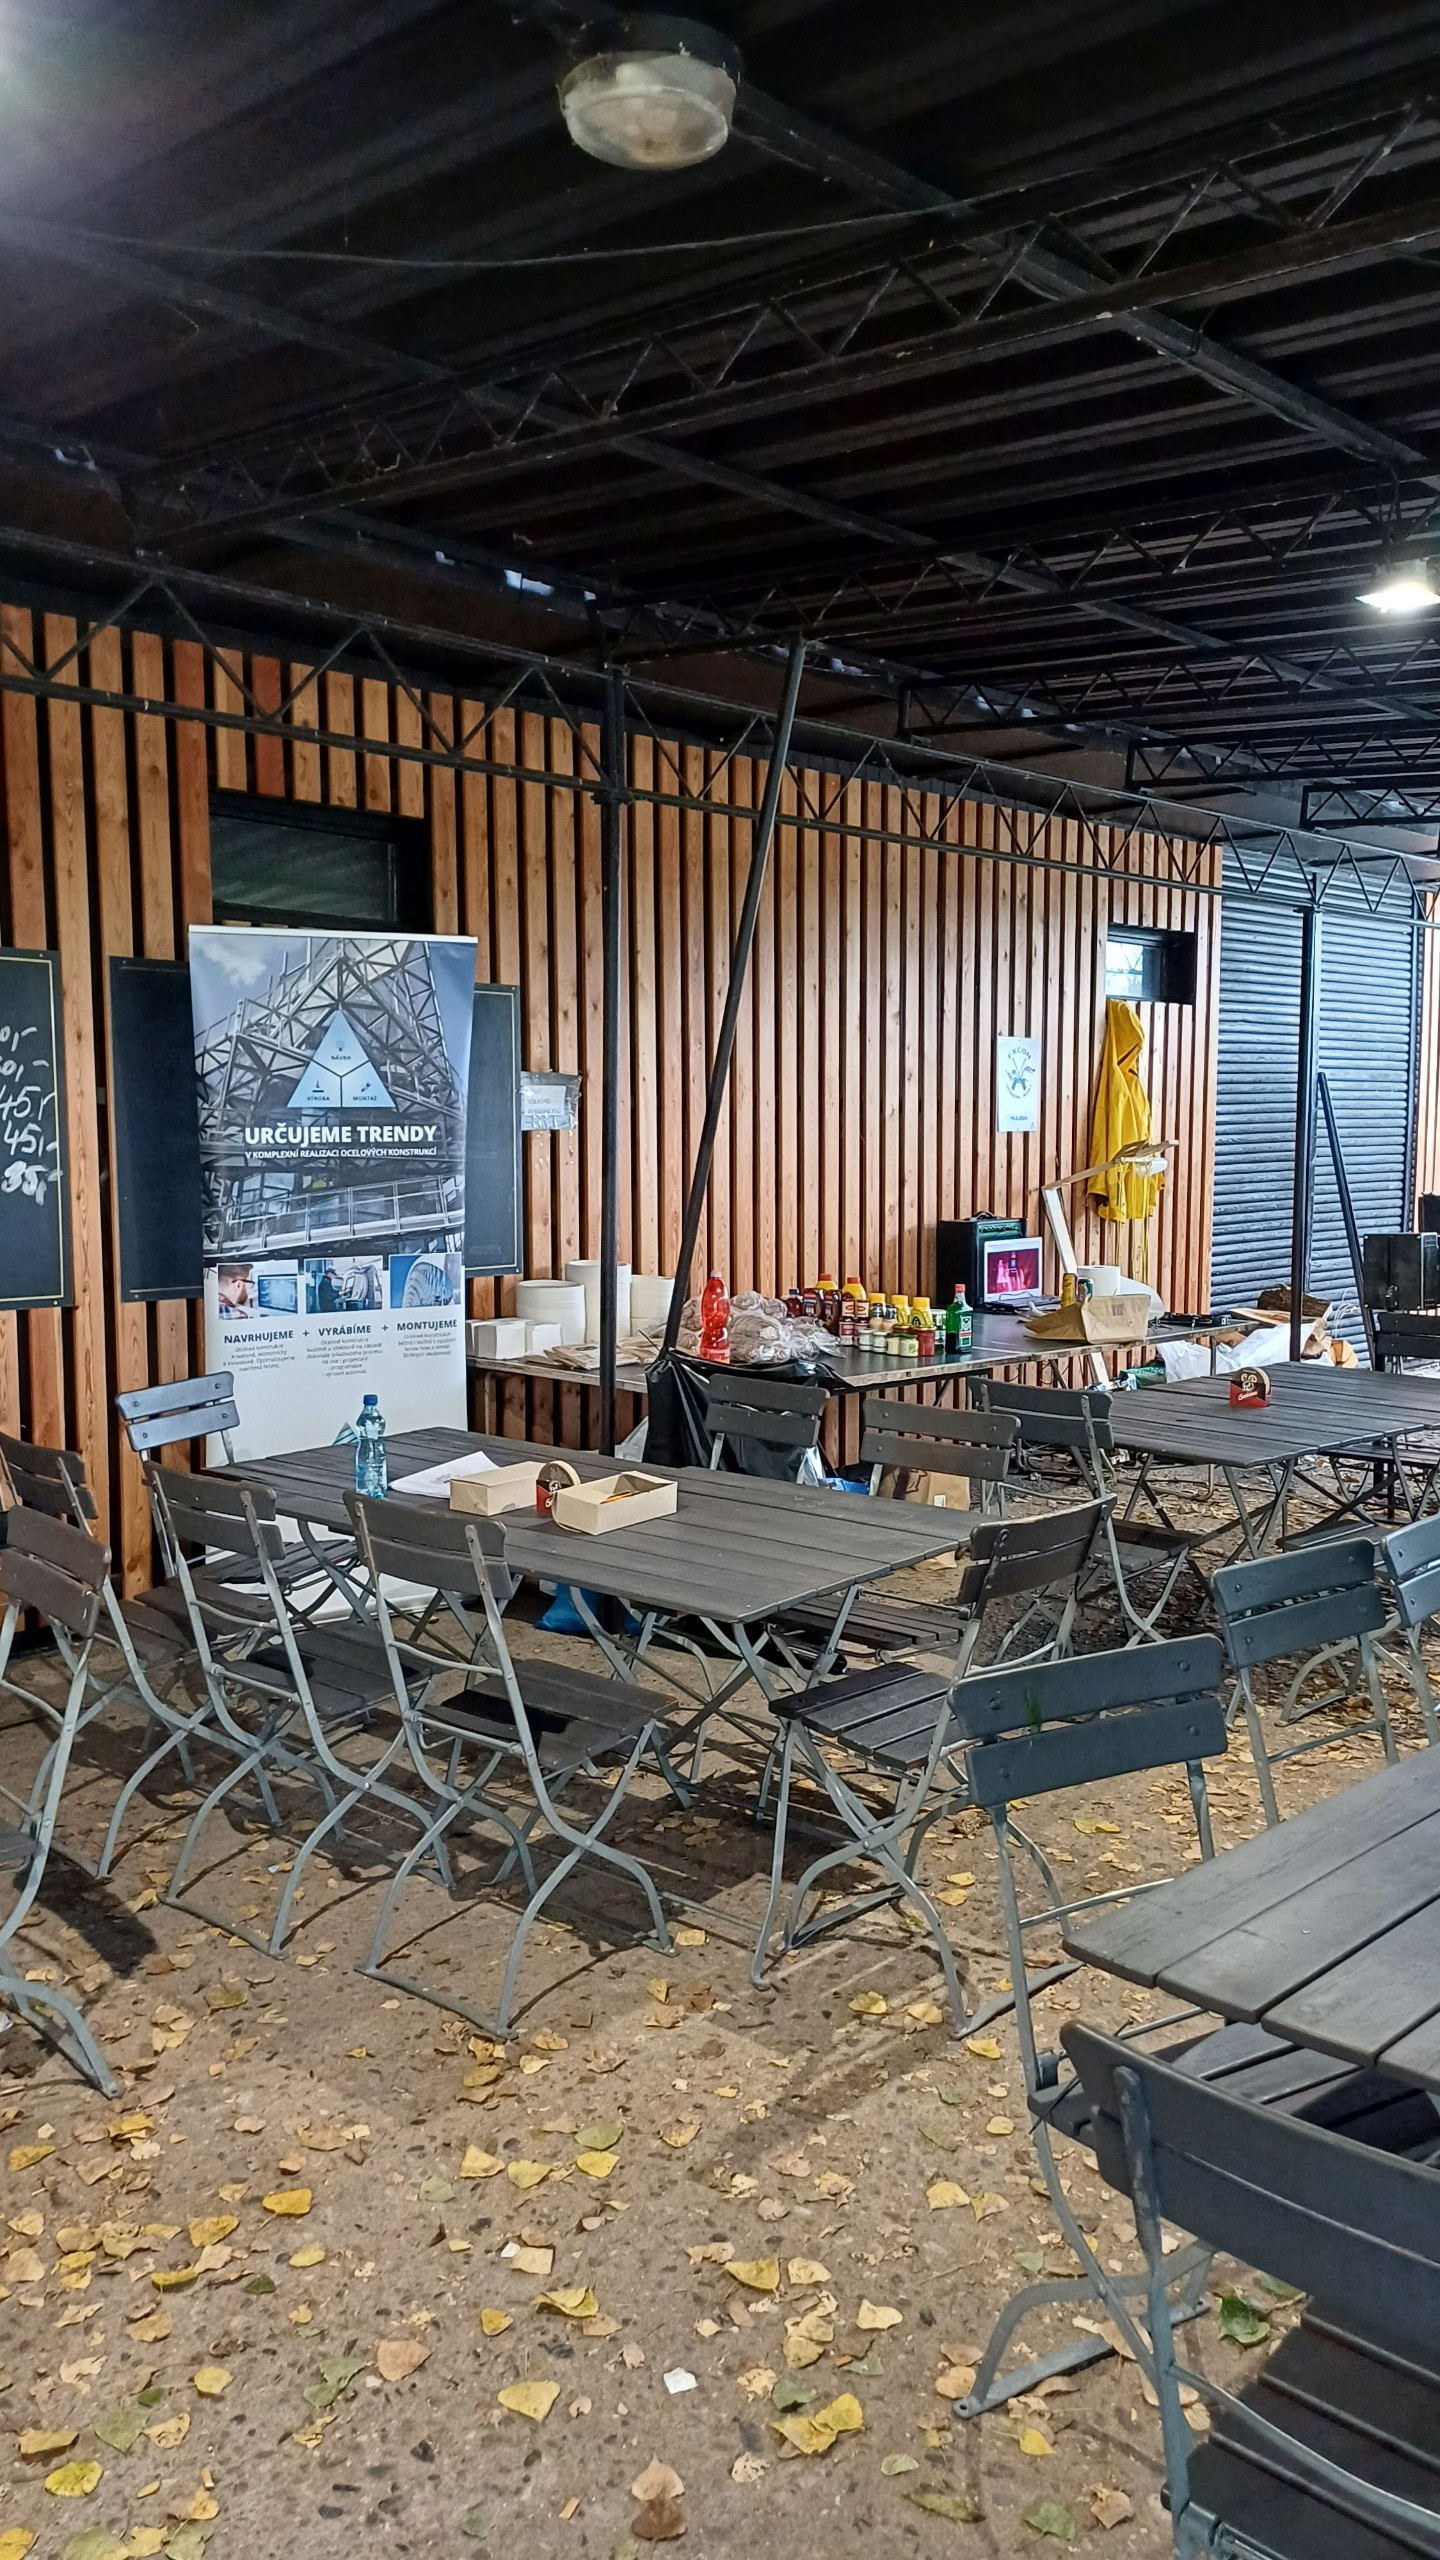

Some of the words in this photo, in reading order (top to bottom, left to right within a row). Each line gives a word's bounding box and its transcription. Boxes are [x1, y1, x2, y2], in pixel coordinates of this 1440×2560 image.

[245, 1123, 352, 1147] URČUJEME
[357, 1125, 437, 1143] TRENDY
[245, 1151, 251, 1159] V
[253, 1149, 299, 1159] KOMPLEXNÍ
[301, 1149, 339, 1158] REALIZACI
[341, 1148, 387, 1157] OCELOVÝCH
[388, 1146, 437, 1156] KONSTRUKCÍ
[224, 1330, 294, 1344] NAVRHUJEME
[318, 1323, 372, 1336] VYRÁBÍME
[397, 1319, 458, 1331] MONTUJEME
